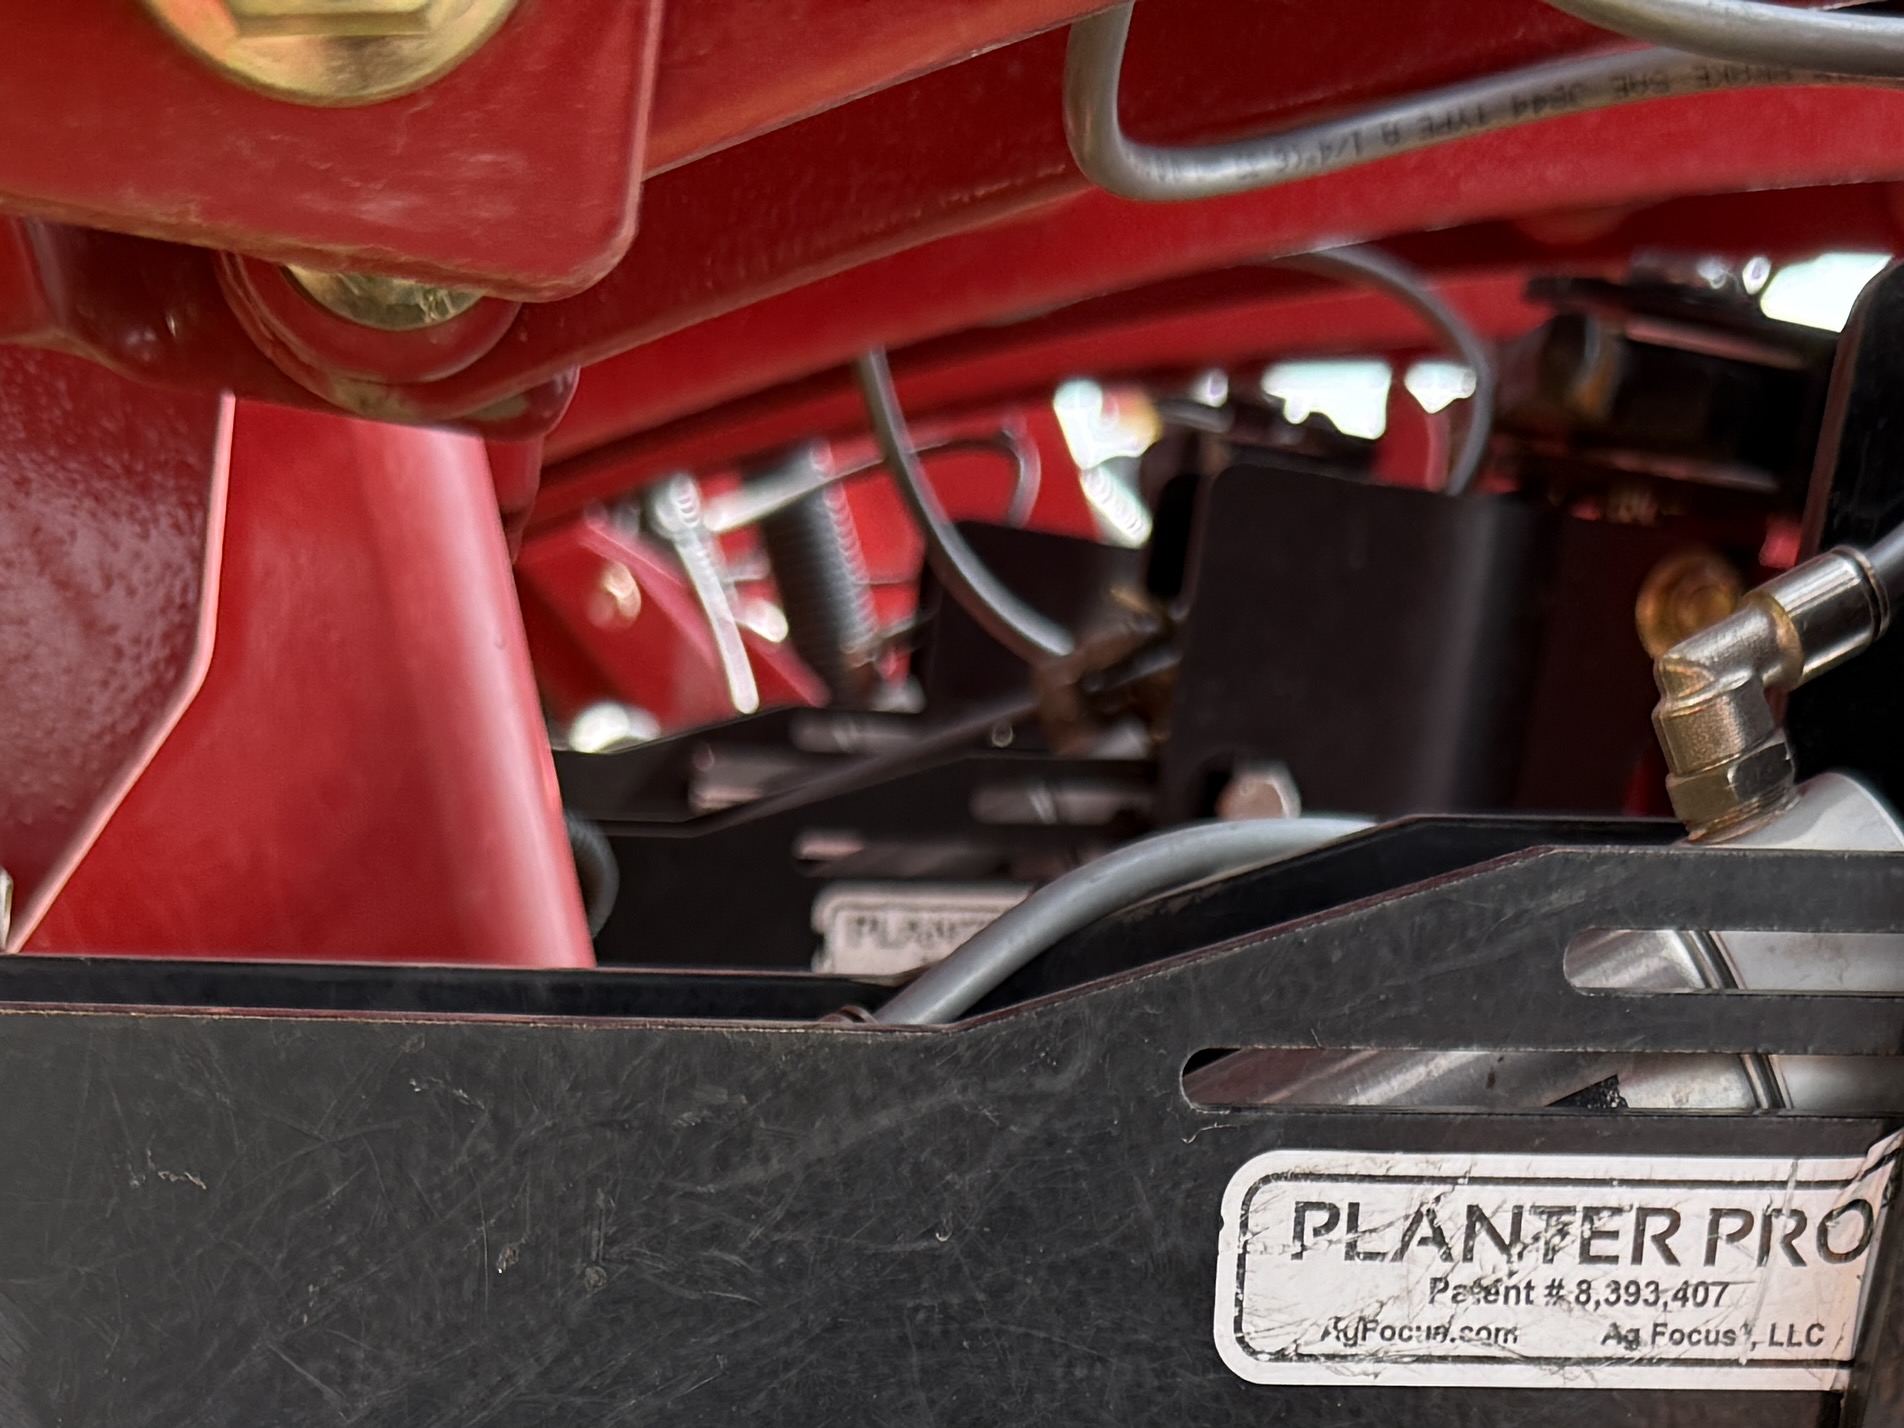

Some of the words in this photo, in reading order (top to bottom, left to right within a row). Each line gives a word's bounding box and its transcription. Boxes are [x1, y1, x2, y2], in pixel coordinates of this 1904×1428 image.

[1290, 1200, 1681, 1267] PLANTER
[1704, 1197, 1875, 1268] PRO
[1428, 1276, 1536, 1306] Patent
[1544, 1278, 1566, 1306] #
[1574, 1278, 1732, 1312] 8,393,407
[1600, 1321, 1641, 1350] Ag
[1767, 1322, 1827, 1348] LLC
